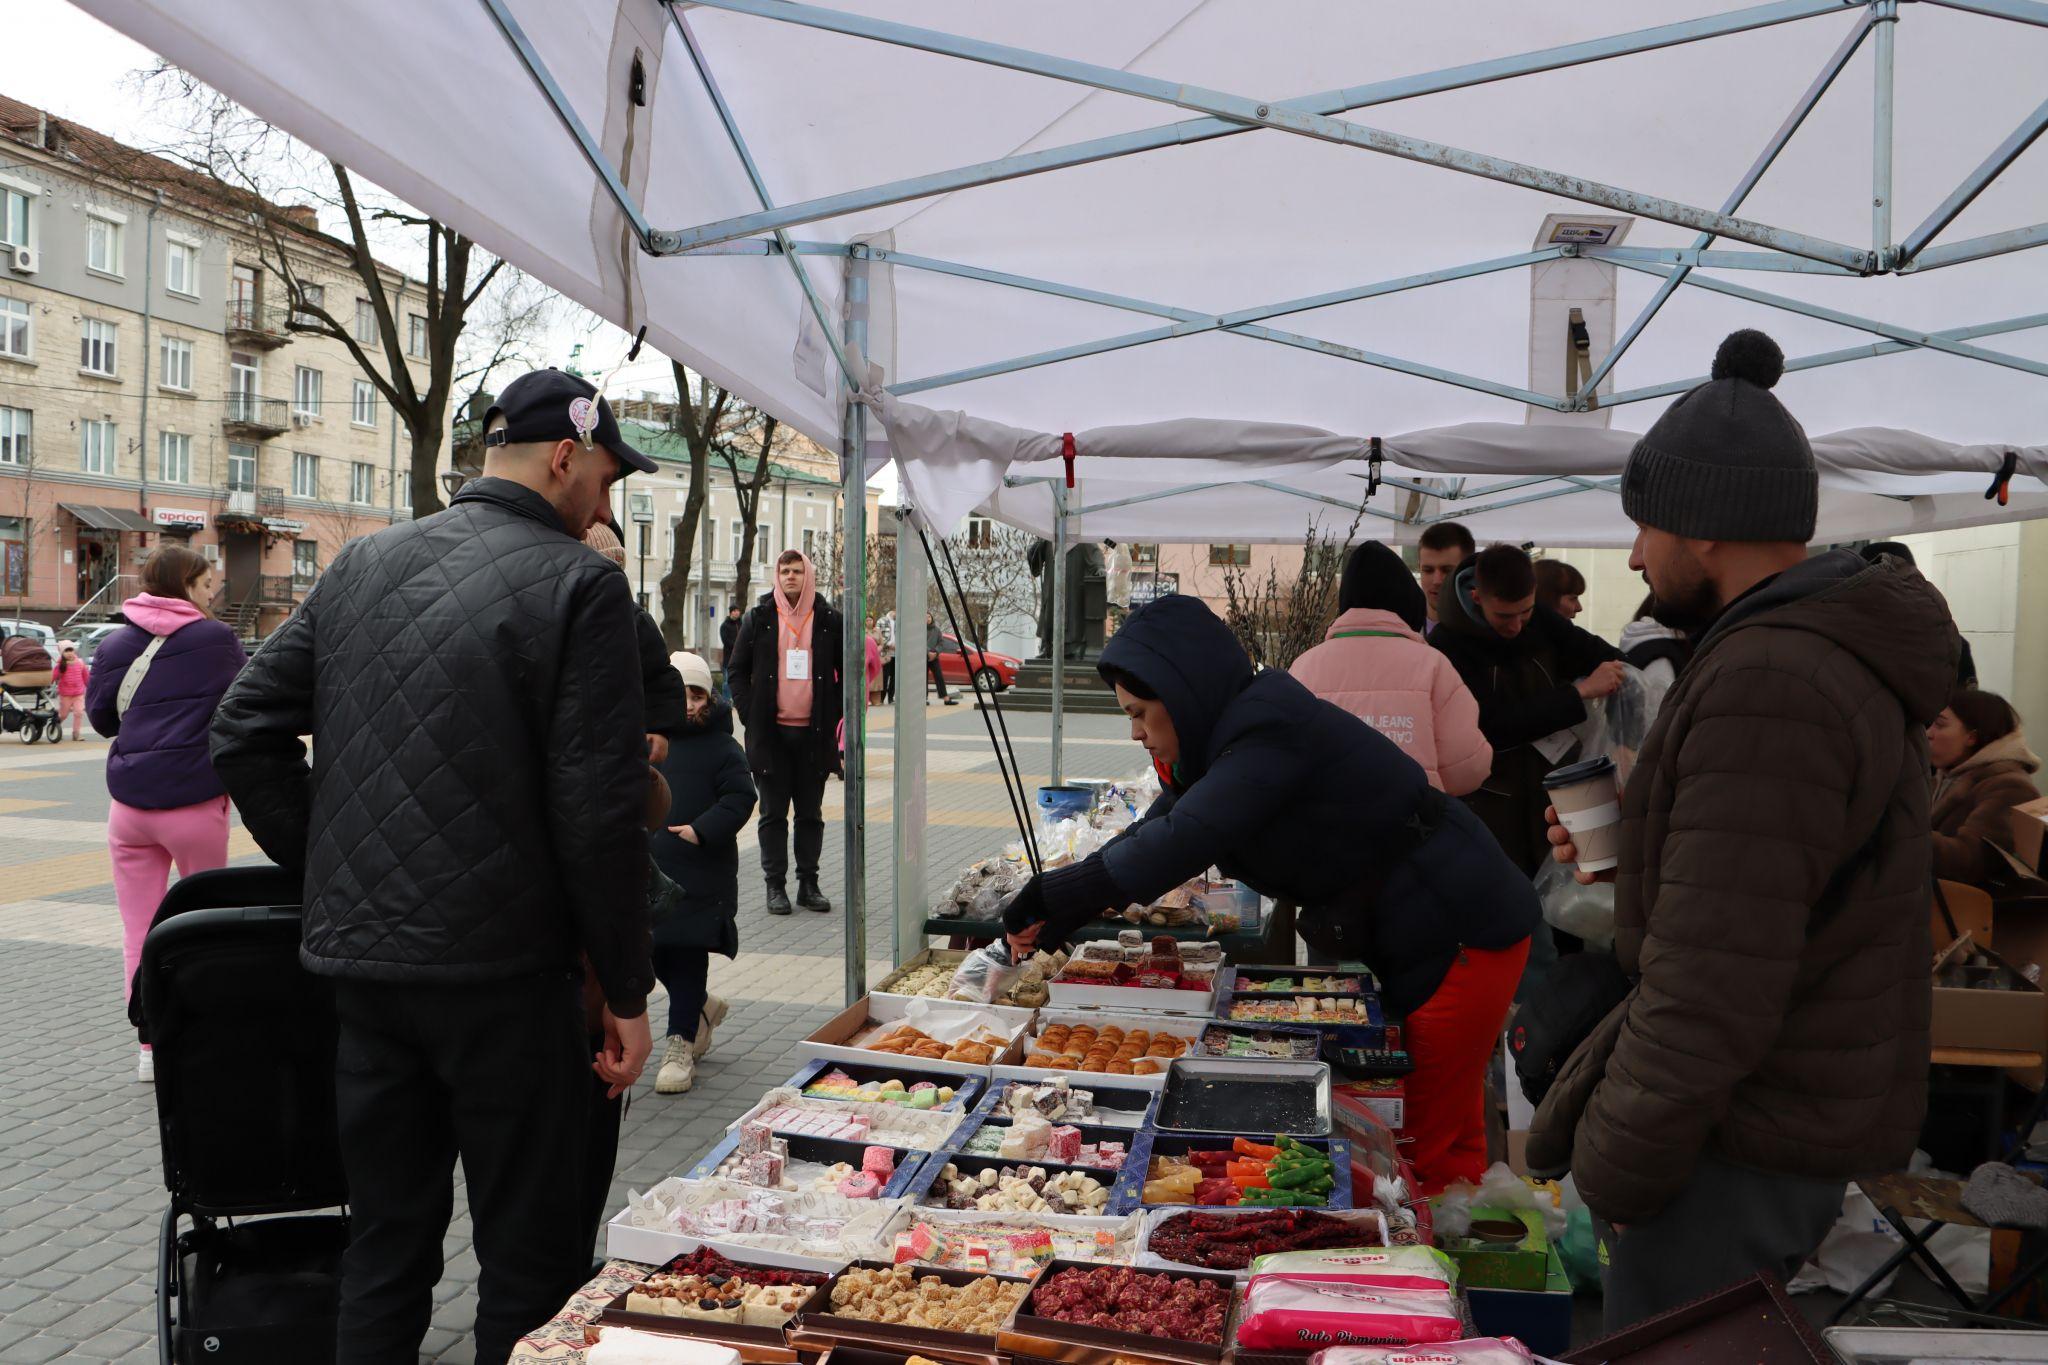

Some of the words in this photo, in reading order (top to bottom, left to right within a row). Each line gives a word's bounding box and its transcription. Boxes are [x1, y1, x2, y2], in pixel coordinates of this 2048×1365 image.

[159, 512, 205, 523] apriori
[1376, 714, 1414, 729] JEANS
[1297, 1328, 1332, 1342] Rulo
